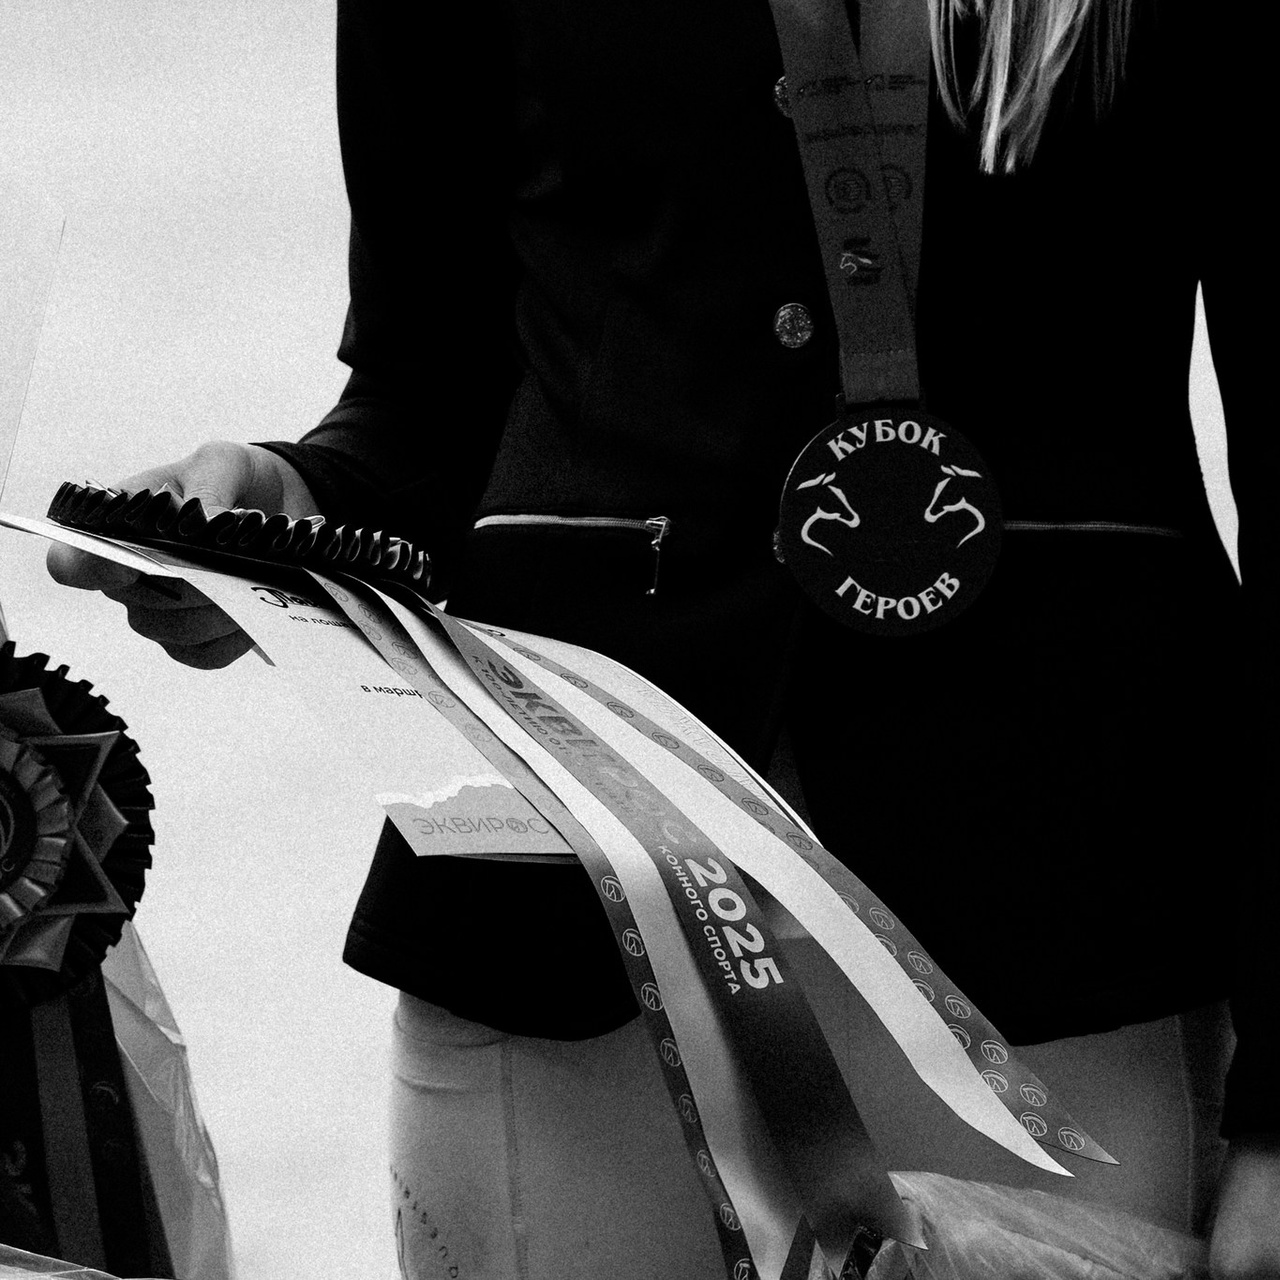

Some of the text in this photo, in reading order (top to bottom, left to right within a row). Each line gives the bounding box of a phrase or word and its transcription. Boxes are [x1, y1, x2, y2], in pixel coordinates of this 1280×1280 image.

[826, 419, 948, 462] КУБОК
[835, 571, 961, 621] ГЕРОЕВ
[360, 685, 371, 693] в
[412, 817, 551, 835] ЭКВИРОС
[481, 669, 548, 735] 100-ЛЕТИЮ
[658, 845, 709, 921] КОННОГО
[703, 925, 741, 995] СПОРТА
[684, 857, 784, 990] 2025
